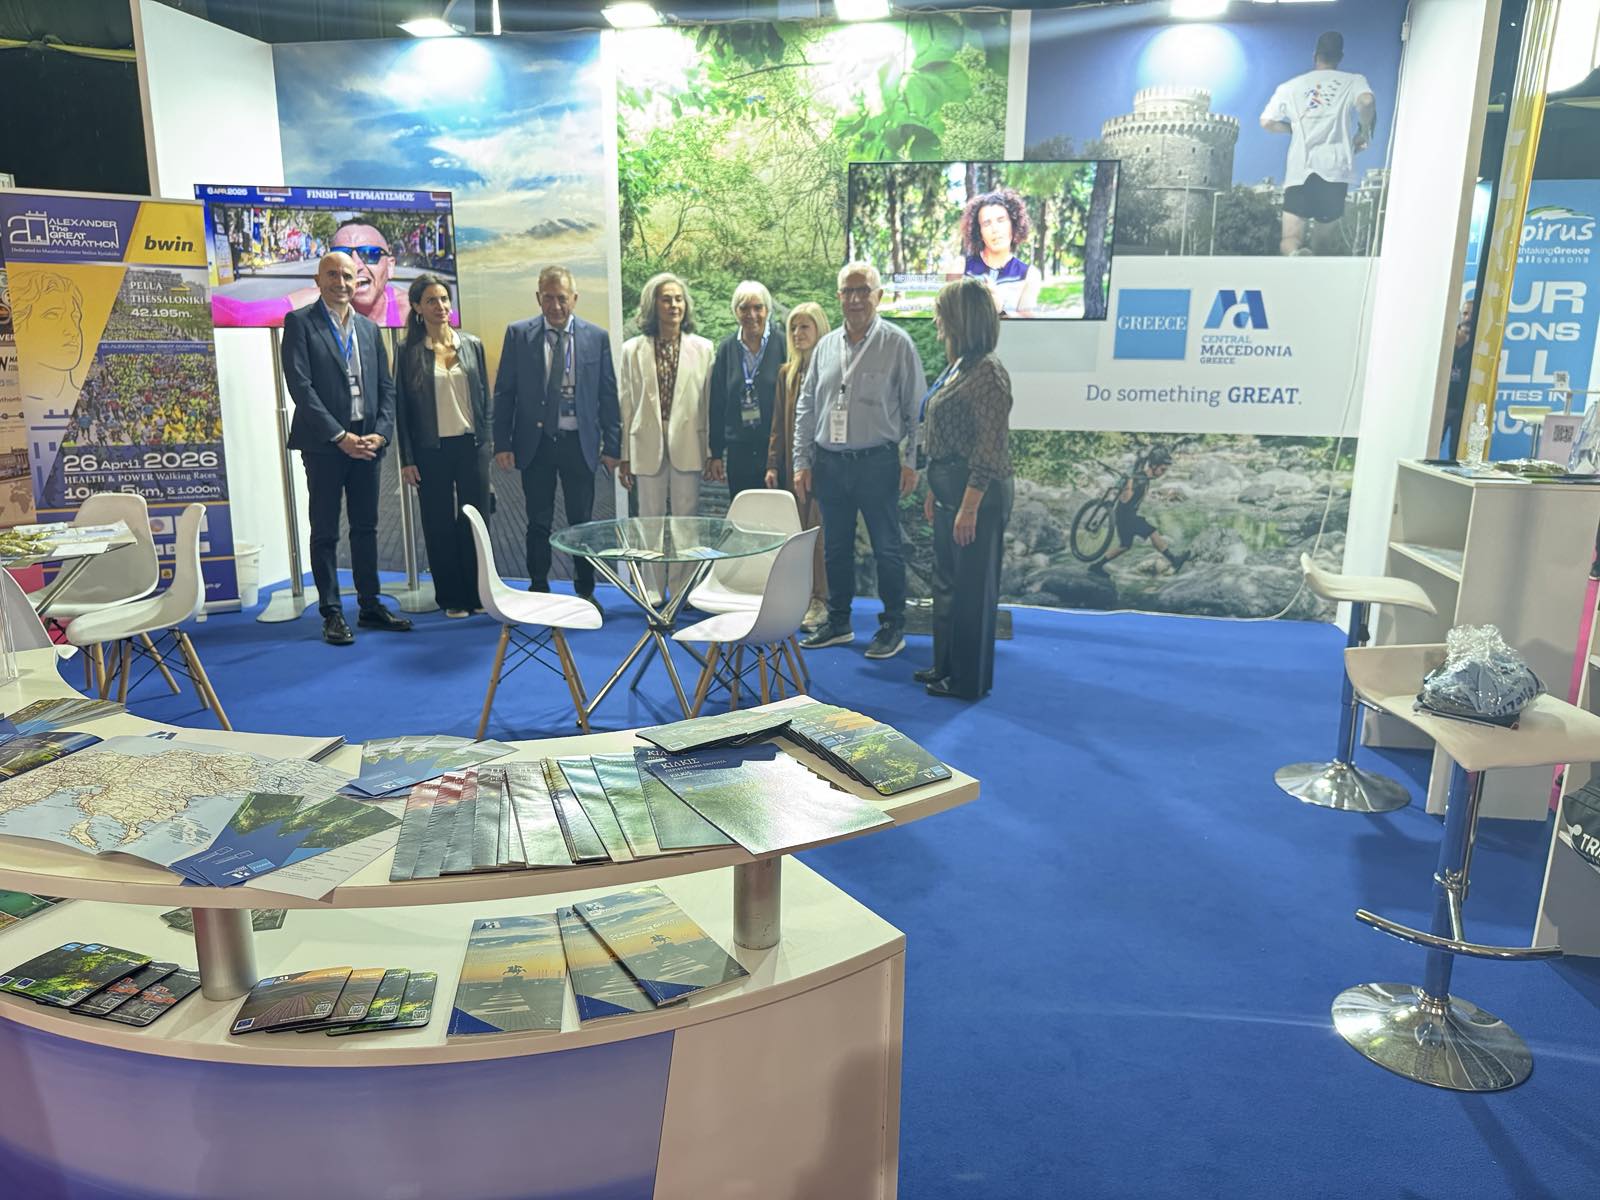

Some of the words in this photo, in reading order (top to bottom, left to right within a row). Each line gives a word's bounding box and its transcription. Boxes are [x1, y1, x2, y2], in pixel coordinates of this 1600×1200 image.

[48, 218, 117, 228] ALEXANDER
[49, 231, 87, 239] GREAT
[51, 239, 120, 249] MARATHON
[144, 235, 194, 252] bwin
[130, 281, 163, 290] PELLA
[132, 295, 204, 305] THESSALONIKI
[1117, 315, 1187, 331] GREECE
[1201, 335, 1252, 344] CENTRAL
[1200, 345, 1293, 357] MACEDONIA
[1199, 356, 1236, 365] GREECE
[1086, 384, 1111, 402] Do
[1116, 385, 1221, 408] something
[63, 455, 98, 472] 26
[101, 459, 142, 471] April
[143, 451, 218, 469] 2026
[64, 474, 106, 485] HEALTH
[118, 473, 154, 482] POWER
[155, 472, 192, 482] Walking
[193, 471, 217, 480] Races
